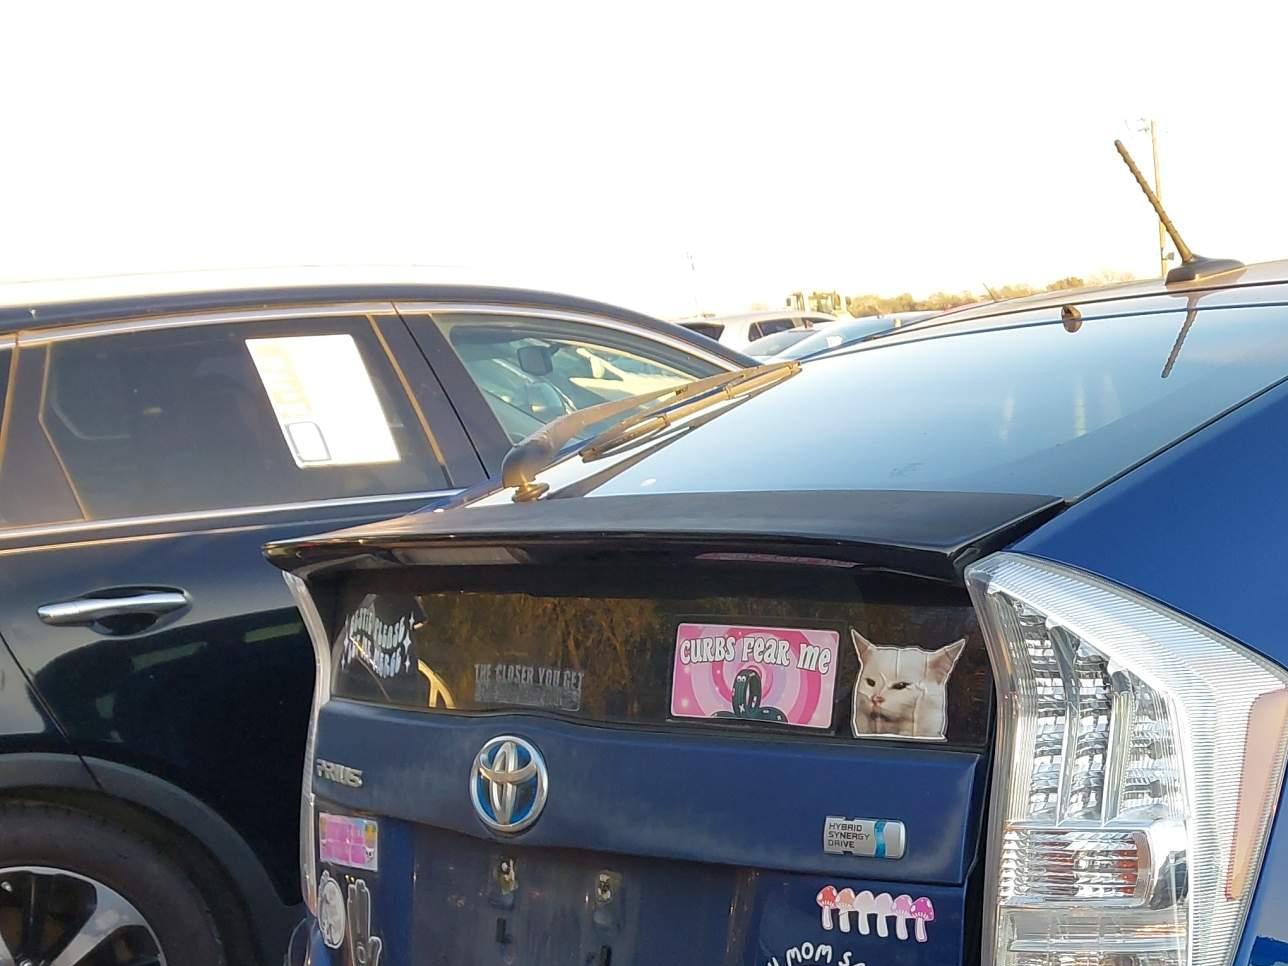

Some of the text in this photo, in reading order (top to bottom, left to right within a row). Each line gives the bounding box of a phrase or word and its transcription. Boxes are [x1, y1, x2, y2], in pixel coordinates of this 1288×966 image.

[474, 663, 584, 689] THE CLOSER YOU GET
[317, 759, 363, 788] PRIUS
[829, 823, 863, 832] HYBRID
[828, 831, 870, 840] SYNERGY
[828, 840, 855, 849] DRIVE
